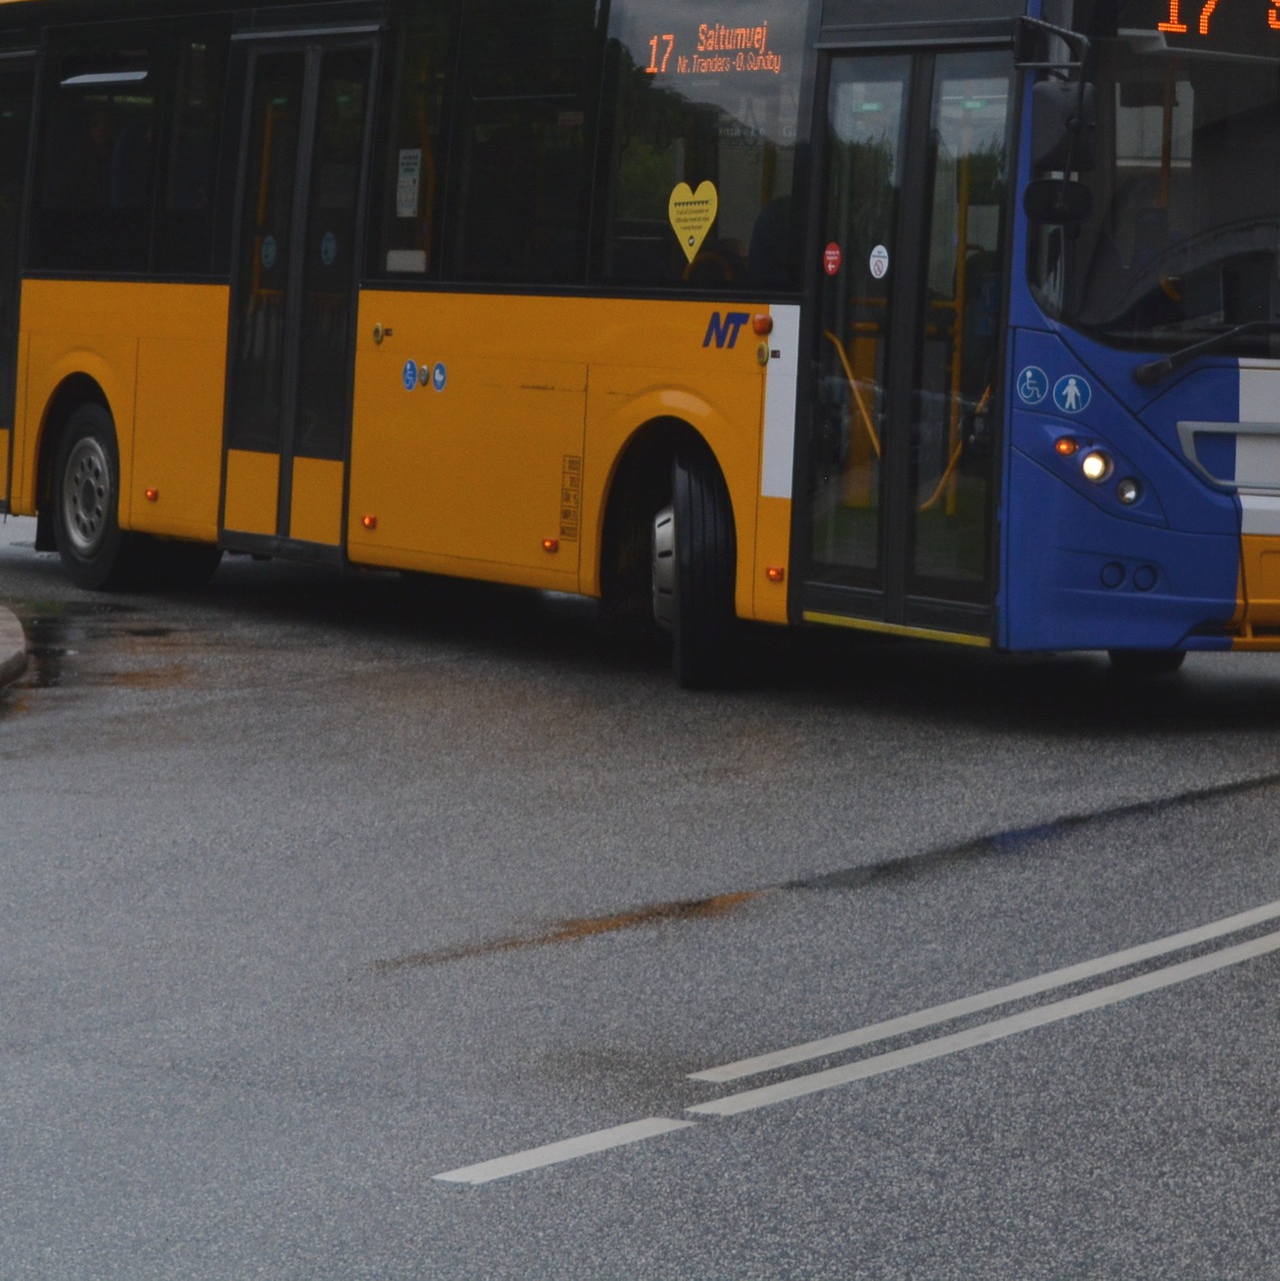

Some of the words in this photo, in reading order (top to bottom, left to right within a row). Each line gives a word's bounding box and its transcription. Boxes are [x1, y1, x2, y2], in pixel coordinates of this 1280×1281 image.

[645, 33, 674, 74] 17
[697, 20, 768, 54] Saltumvej
[701, 311, 751, 349] NT
